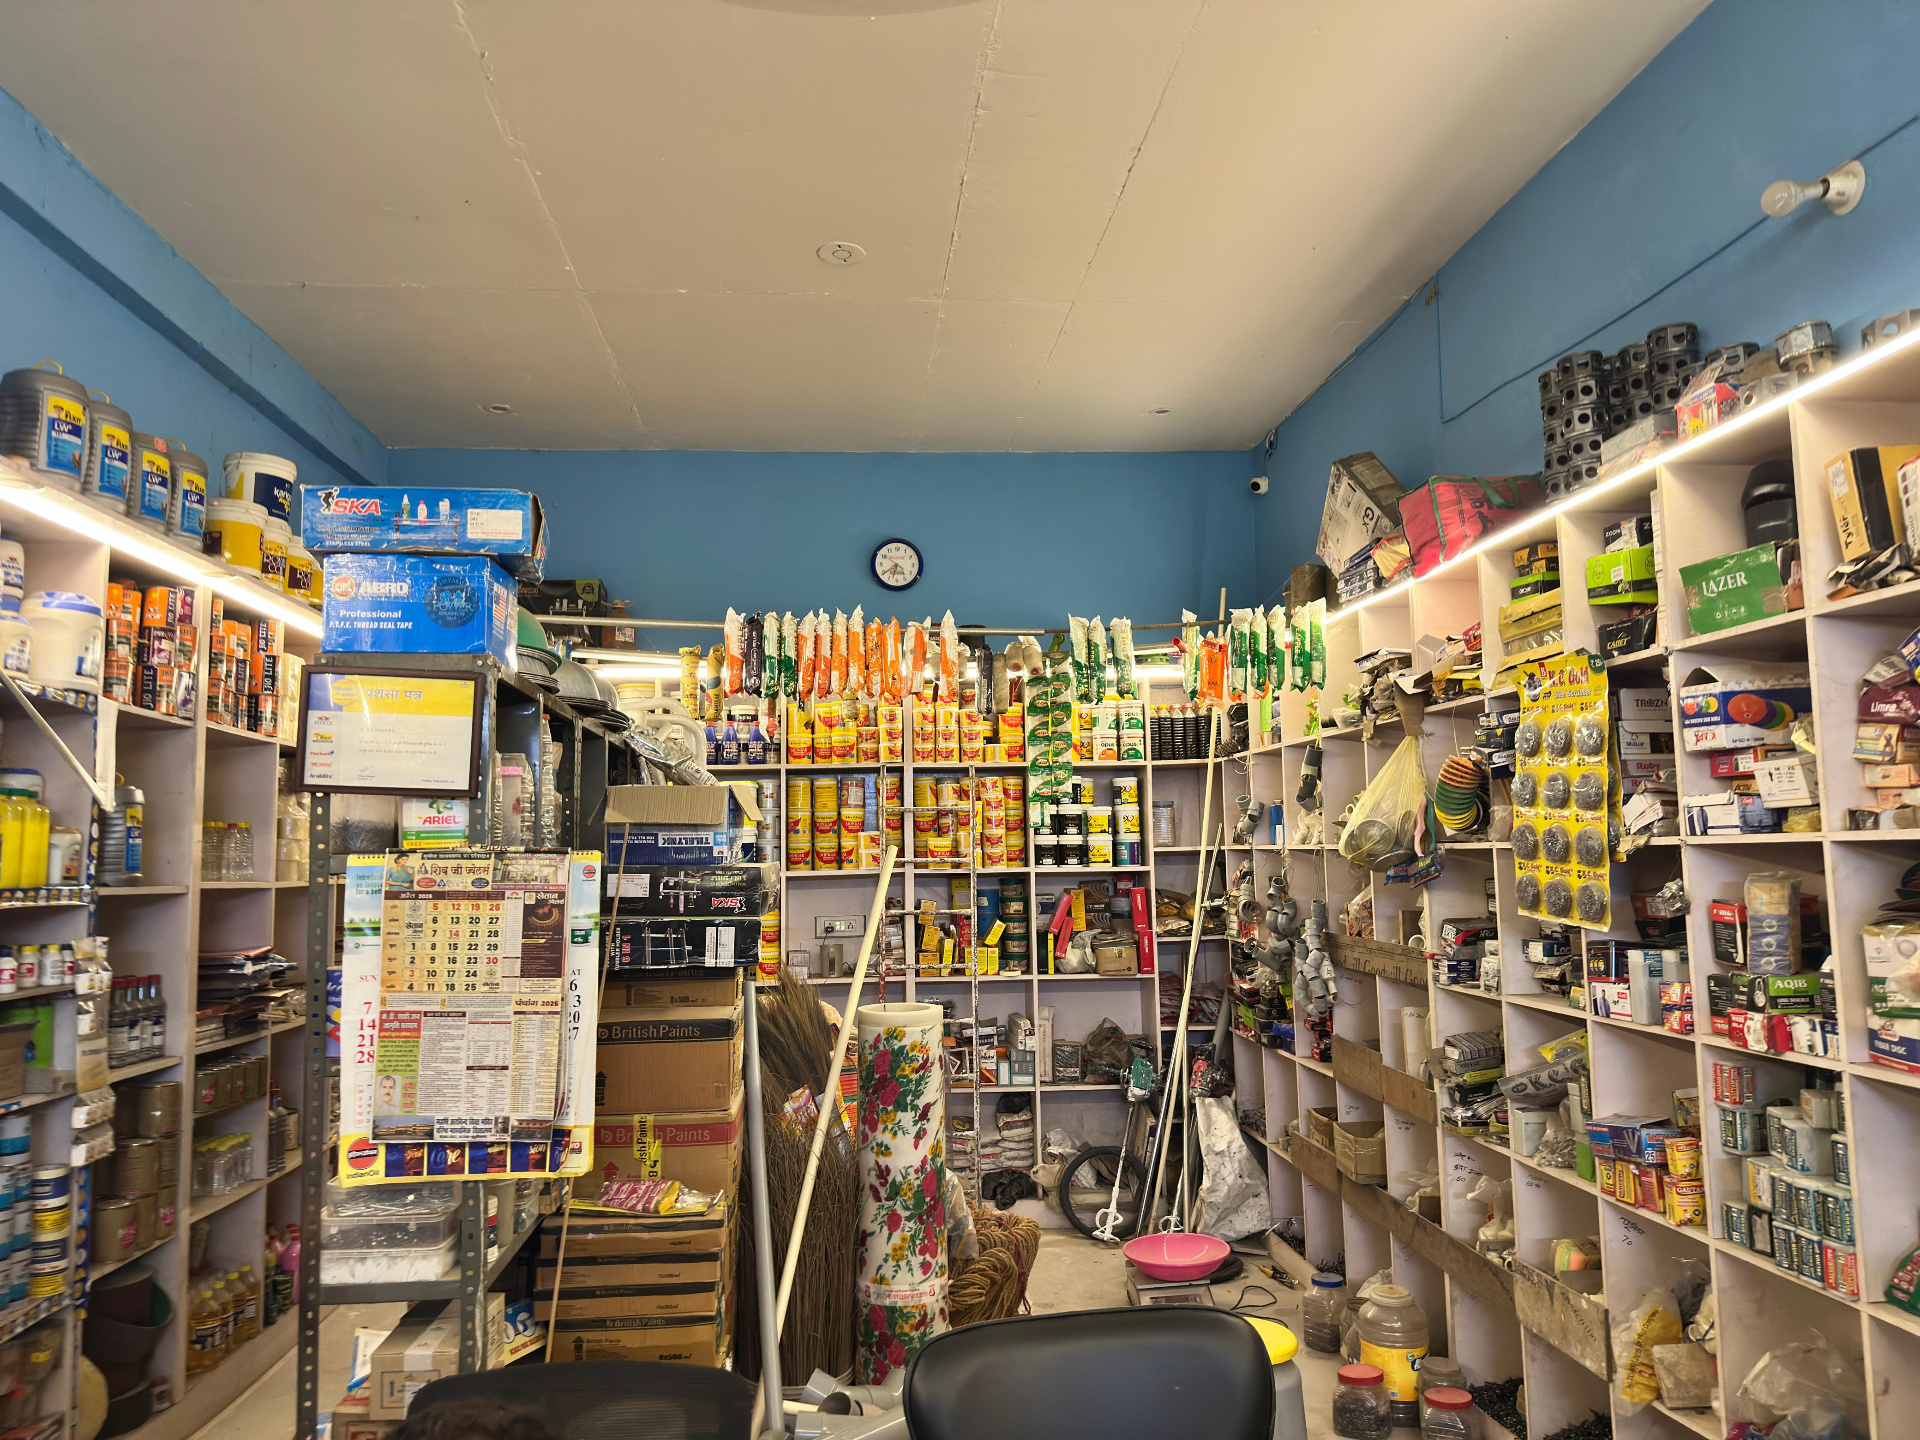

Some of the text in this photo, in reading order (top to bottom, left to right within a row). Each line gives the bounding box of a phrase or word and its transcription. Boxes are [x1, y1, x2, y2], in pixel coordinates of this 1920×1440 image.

[332, 500, 381, 516] SKA
[358, 582, 409, 594] ABRO
[1702, 571, 1748, 597] LAZER
[434, 602, 474, 612] POWER
[340, 610, 402, 618] Professional
[354, 621, 378, 629] THREAD
[1607, 637, 1629, 649] CADET
[265, 657, 273, 675] LITE
[143, 669, 153, 690] LITE
[1568, 667, 1589, 685] Gold
[366, 687, 399, 701] प्रशंसा
[404, 689, 423, 701] पत्र
[423, 816, 460, 826] ARIEL
[430, 864, 448, 875] शिव
[451, 864, 463, 875] जी
[433, 903, 501, 911] 5 12 19 26
[712, 898, 739, 907] SKA
[432, 916, 500, 925] 6 13 20 27
[432, 930, 499, 938] 7 14 21 28
[411, 943, 499, 951] 1 8 15 22 29
[622, 944, 631, 954] IN
[410, 957, 498, 965] 2 9 16 23 30
[409, 970, 478, 978] 3 10 17 24
[407, 983, 477, 991] 4 11 18 25
[570, 980, 578, 992] 6
[1774, 980, 1808, 989] AQIB
[363, 1002, 372, 1014] 7
[358, 1018, 377, 1031] 14
[612, 1025, 700, 1039] British Paints
[357, 1035, 375, 1048] 21
[1892, 1044, 1907, 1055] DISC
[356, 1050, 375, 1064] 28
[637, 1116, 647, 1146] Paints
[667, 1128, 710, 1141] Paints
[1646, 1152, 1656, 1162] 25
[346, 1170, 379, 1180] IndianOil
[615, 1319, 641, 1327] British
